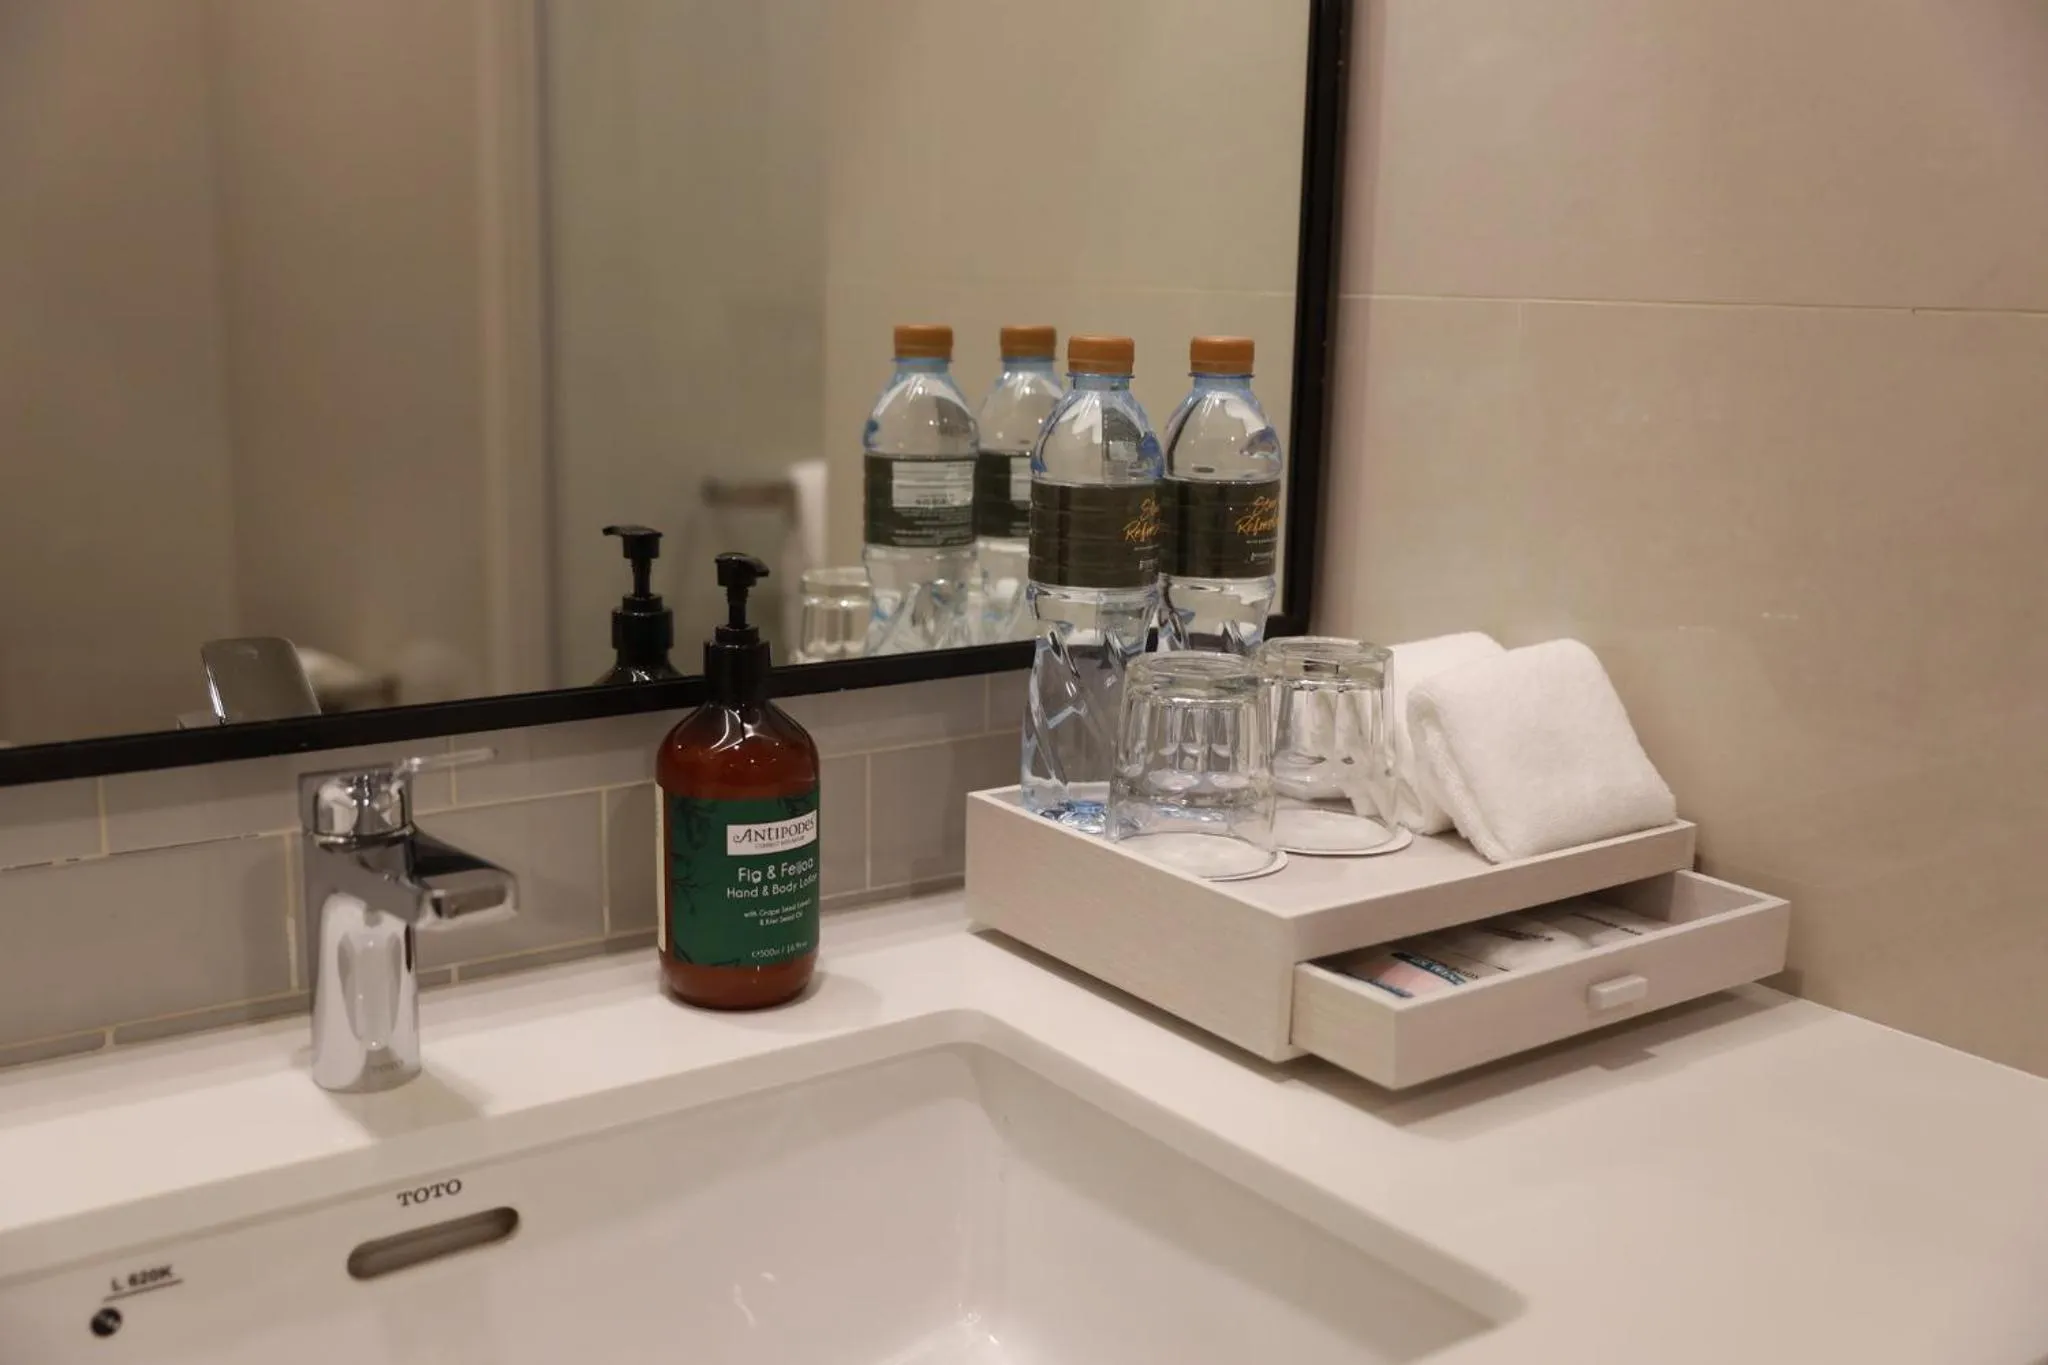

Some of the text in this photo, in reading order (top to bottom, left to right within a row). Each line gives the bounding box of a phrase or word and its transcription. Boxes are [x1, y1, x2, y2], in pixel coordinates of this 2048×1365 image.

[738, 867, 762, 884] Fig
[767, 865, 776, 879] &
[727, 886, 758, 898] Hand
[762, 885, 769, 896] &
[396, 1179, 462, 1207] TOTO
